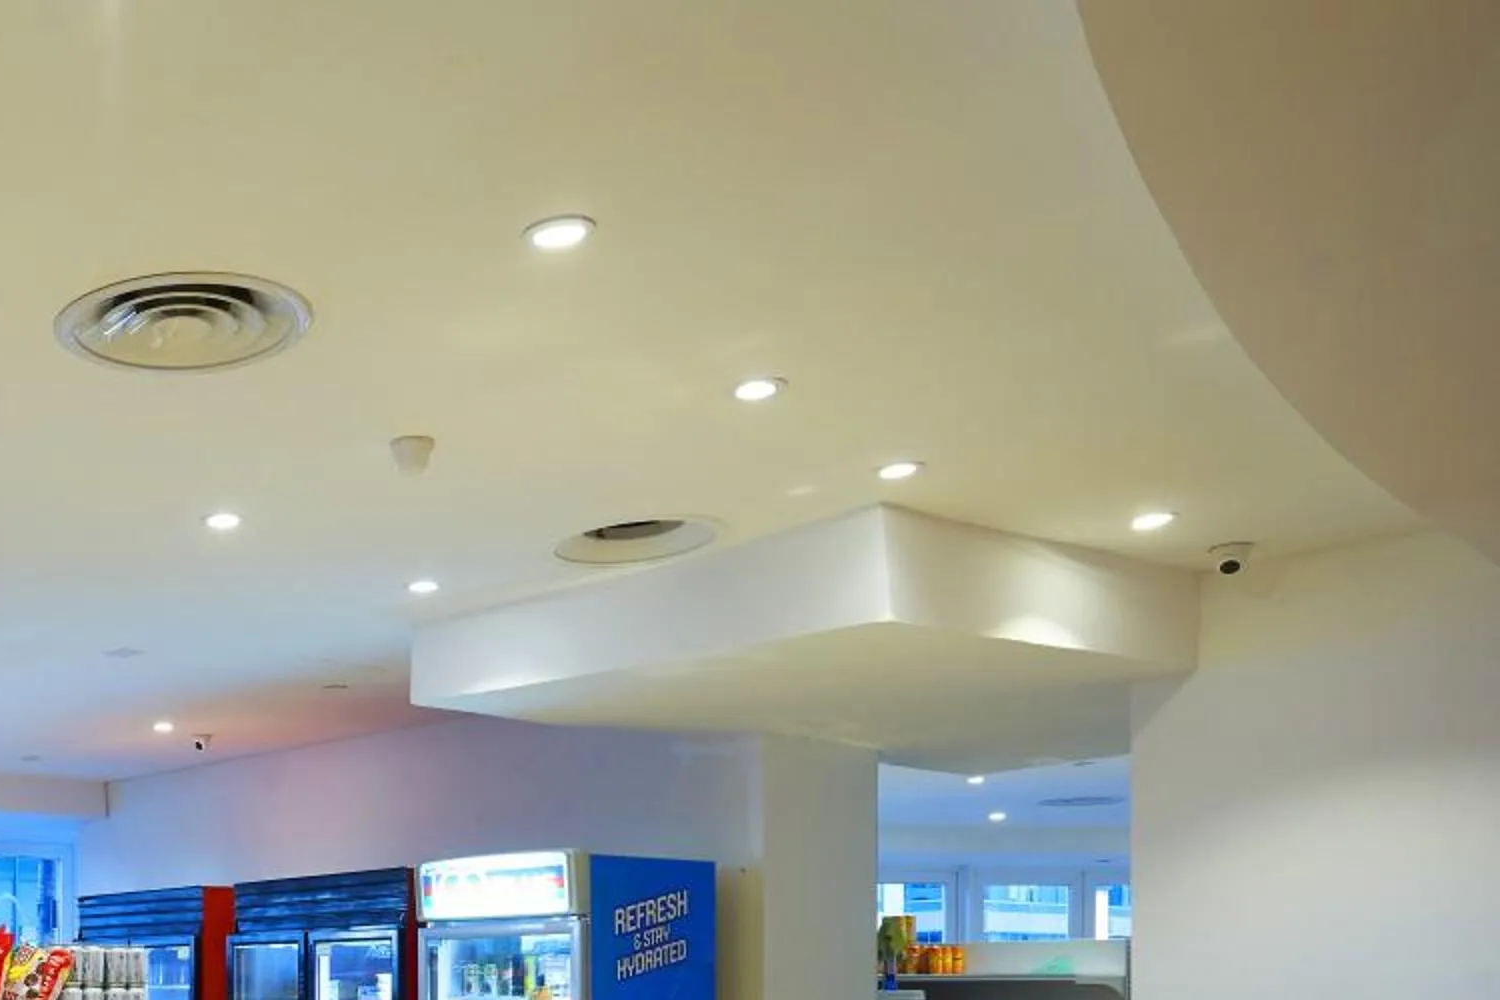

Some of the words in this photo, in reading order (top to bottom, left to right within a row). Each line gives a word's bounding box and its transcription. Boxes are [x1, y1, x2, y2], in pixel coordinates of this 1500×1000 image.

[614, 889, 688, 936] REFRESH
[633, 934, 641, 951] &
[643, 924, 671, 947] STAY
[617, 939, 687, 981] HYDRATED
